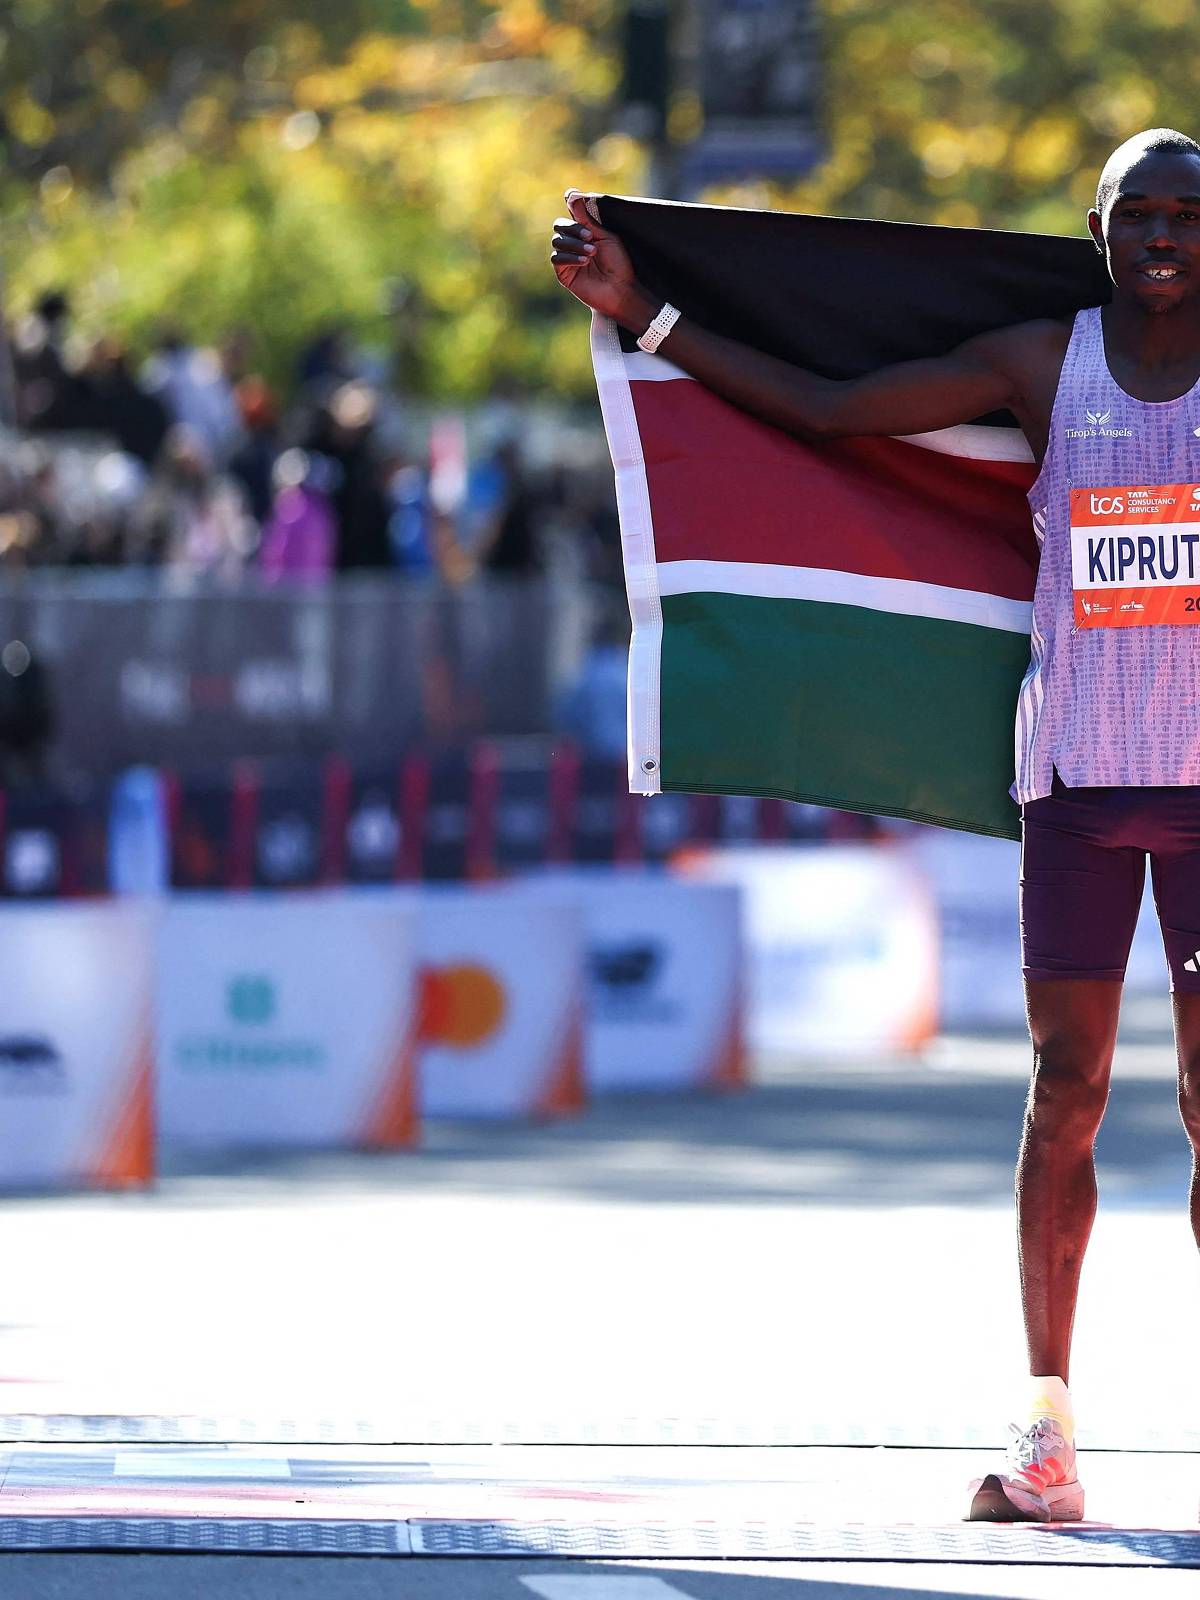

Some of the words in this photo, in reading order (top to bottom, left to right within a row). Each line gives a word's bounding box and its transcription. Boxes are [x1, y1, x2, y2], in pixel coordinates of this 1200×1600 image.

[1065, 427, 1097, 439] Tirop's
[1099, 427, 1133, 438] Angels
[1127, 491, 1149, 499] TATA
[1127, 498, 1176, 506] CONSULTANCY
[1127, 506, 1159, 514] SERVICES
